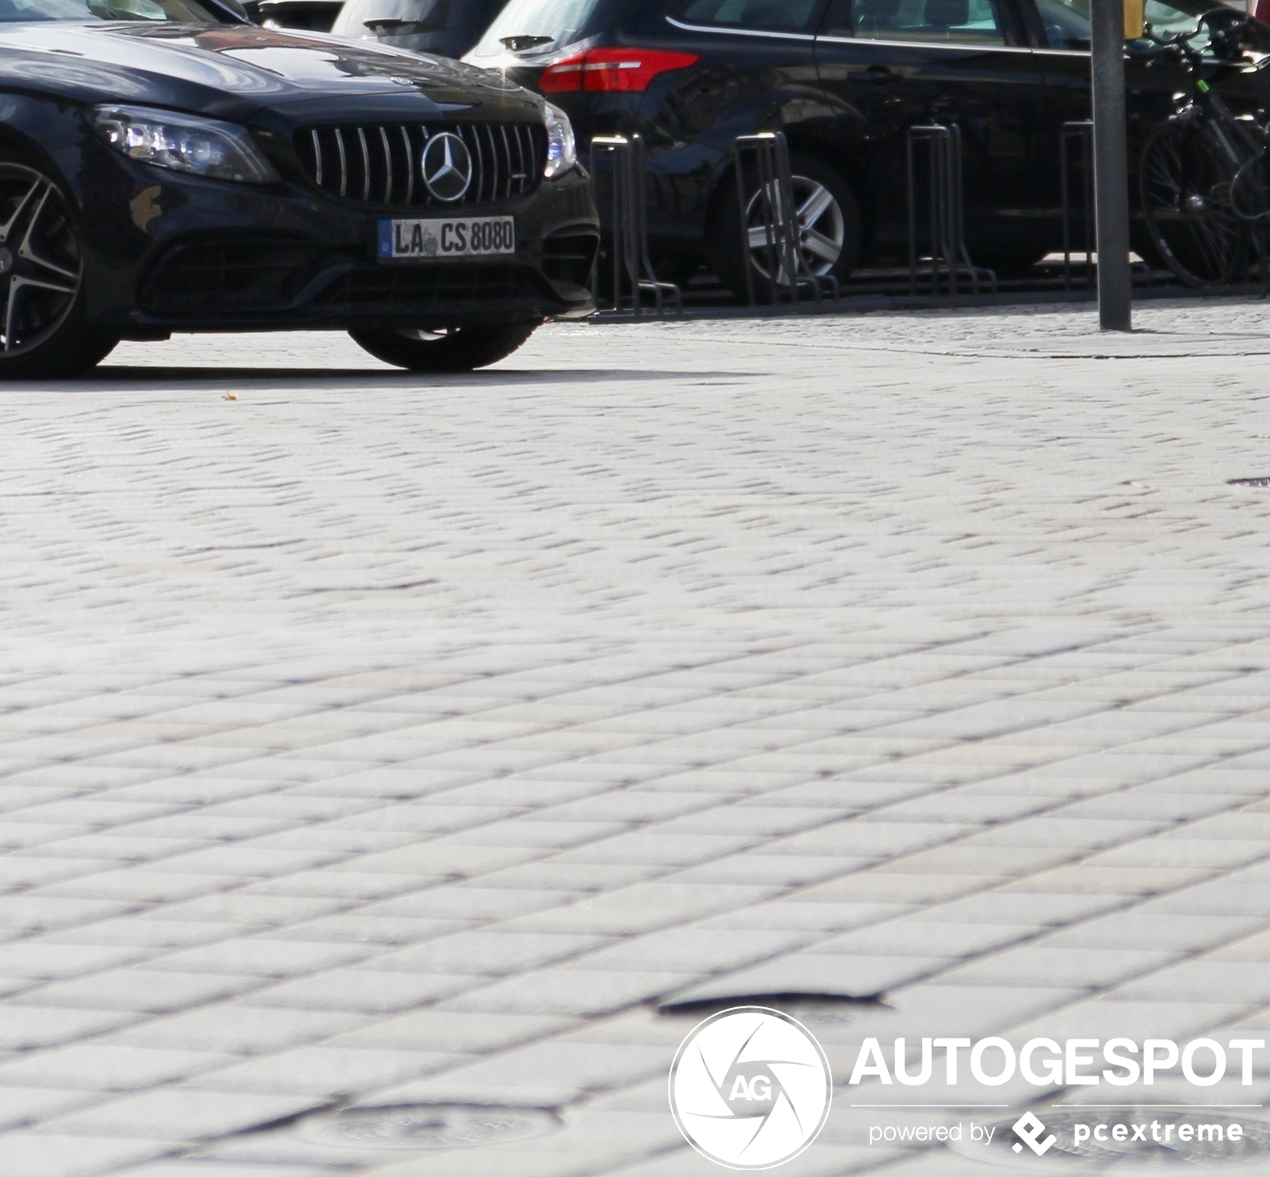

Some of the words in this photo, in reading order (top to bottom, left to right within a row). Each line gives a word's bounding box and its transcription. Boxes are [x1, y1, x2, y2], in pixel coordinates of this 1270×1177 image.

[395, 223, 424, 254] LA
[441, 222, 468, 252] CS
[470, 220, 513, 251] 8080
